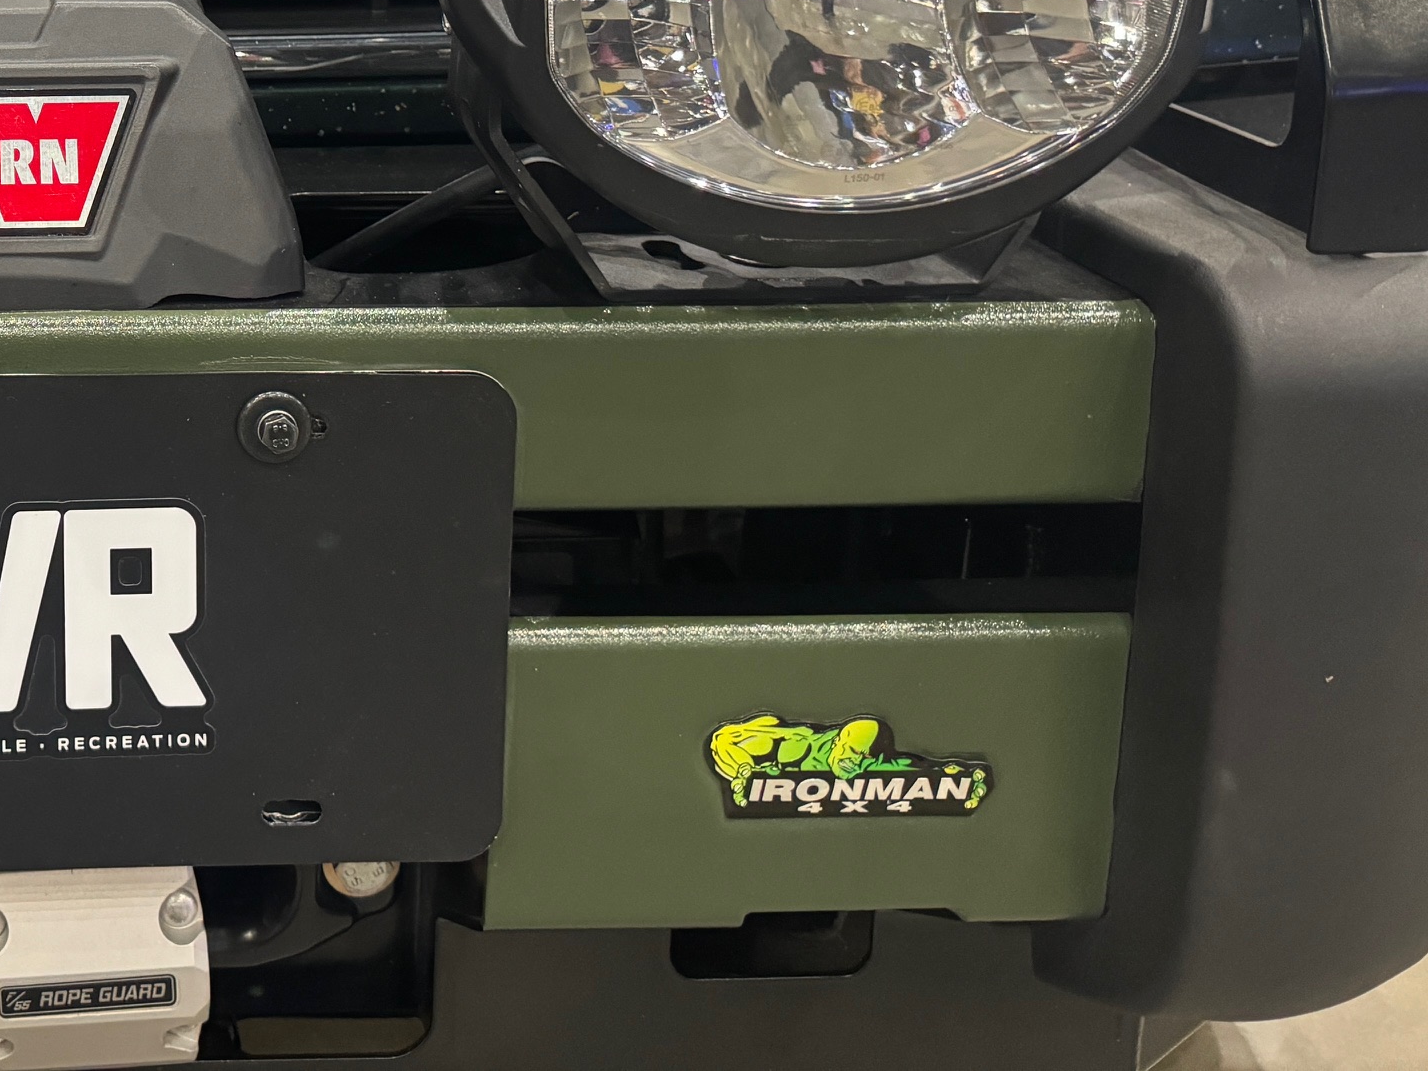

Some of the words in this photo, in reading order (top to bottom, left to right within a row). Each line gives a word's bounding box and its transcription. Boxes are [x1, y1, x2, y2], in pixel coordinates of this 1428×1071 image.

[57, 732, 209, 752] RECREATION
[748, 777, 972, 802] IRONMAN
[39, 987, 94, 1008] ROPE
[98, 982, 167, 1003] GUARD
